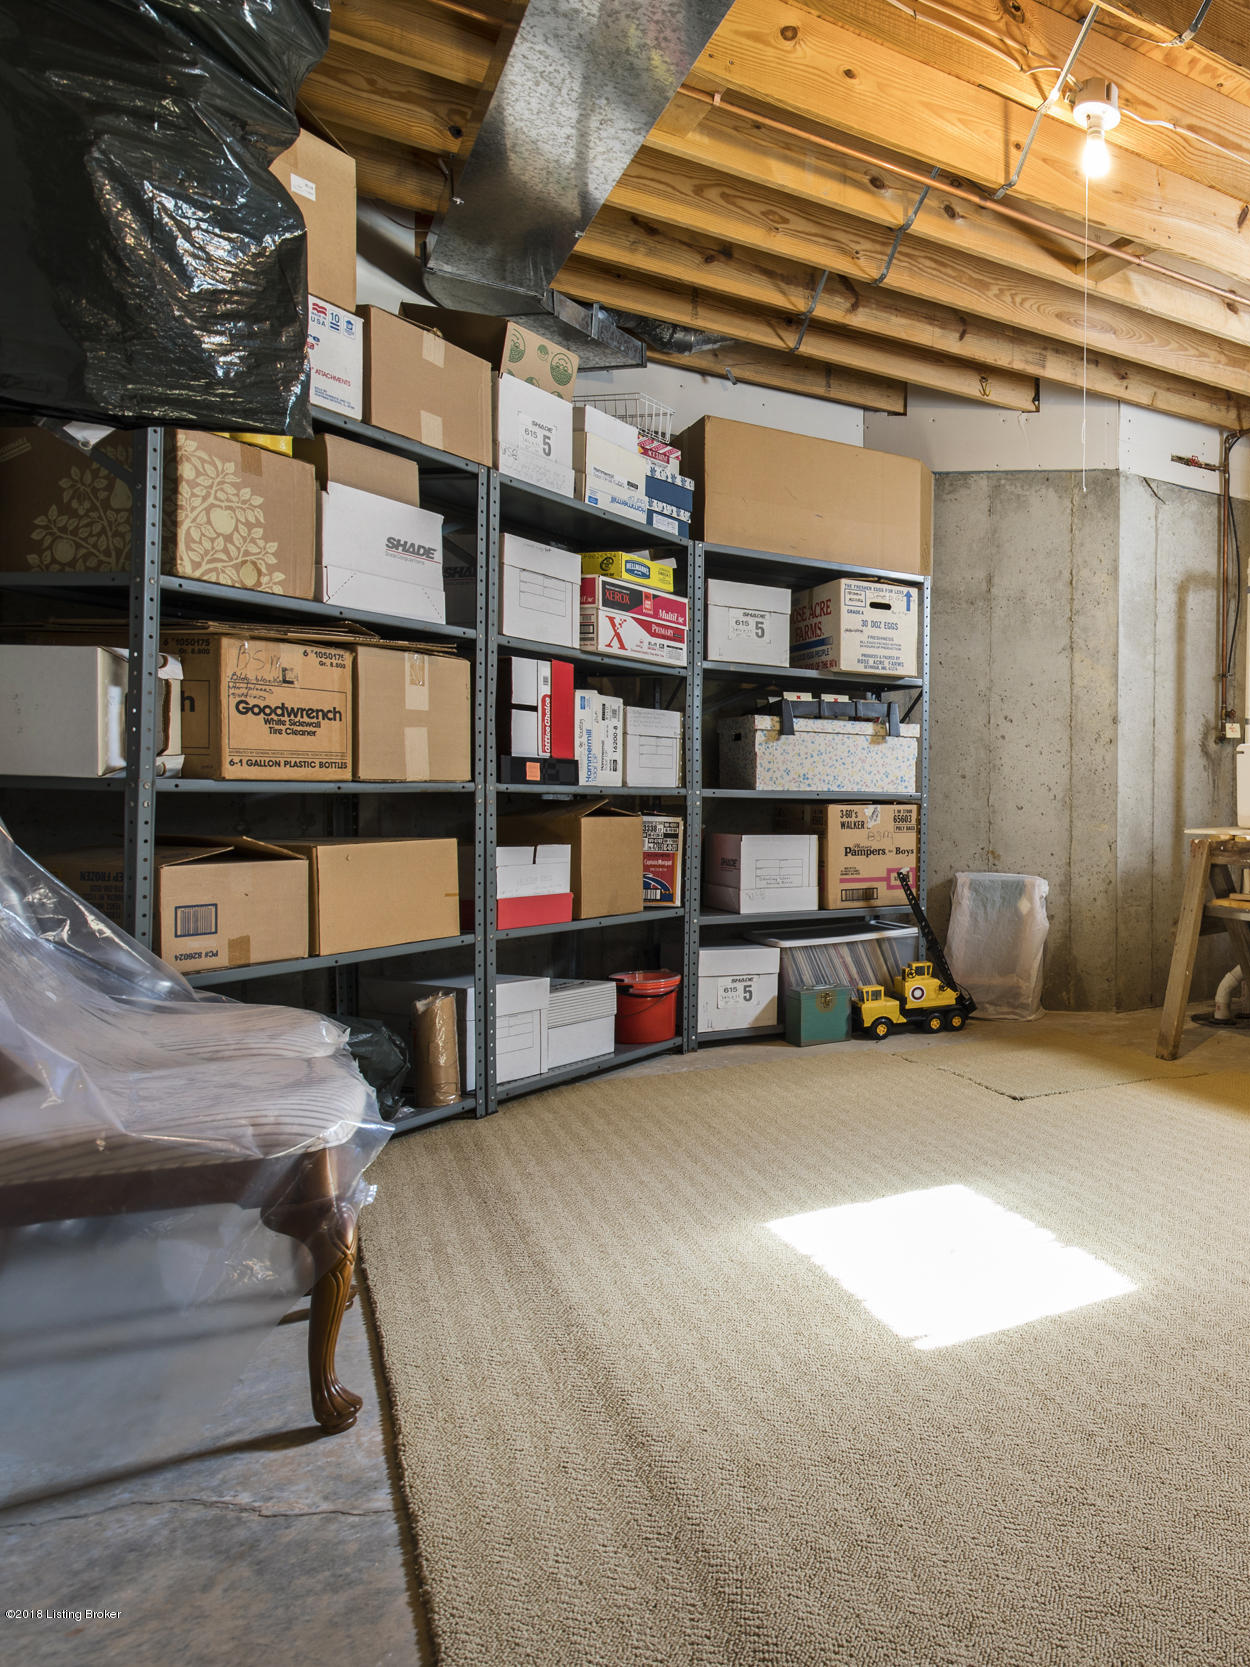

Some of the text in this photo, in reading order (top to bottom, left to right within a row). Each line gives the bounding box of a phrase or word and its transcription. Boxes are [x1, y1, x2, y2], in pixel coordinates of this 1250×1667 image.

[542, 434, 552, 457] 5
[385, 536, 438, 560] SHADE
[604, 589, 631, 605] XEROX
[808, 599, 832, 620] ACRE
[735, 619, 750, 627] 615
[755, 621, 765, 639] 5
[861, 619, 899, 631] 30 DOZ EGGS
[302, 649, 309, 657] 6
[234, 699, 342, 722] Goodwrench
[263, 716, 322, 729] White Sidewall
[268, 726, 317, 737] Tire Cleaner
[585, 729, 593, 783] Hammermill
[228, 758, 348, 770] 6-1 GALLON PLASTIC BOTTLES
[840, 820, 865, 831] WALKER
[893, 814, 912, 824] 65603
[895, 847, 915, 857] Boys
[174, 951, 202, 961] 826024
[723, 986, 738, 994] 615
[743, 984, 753, 1002] 5
